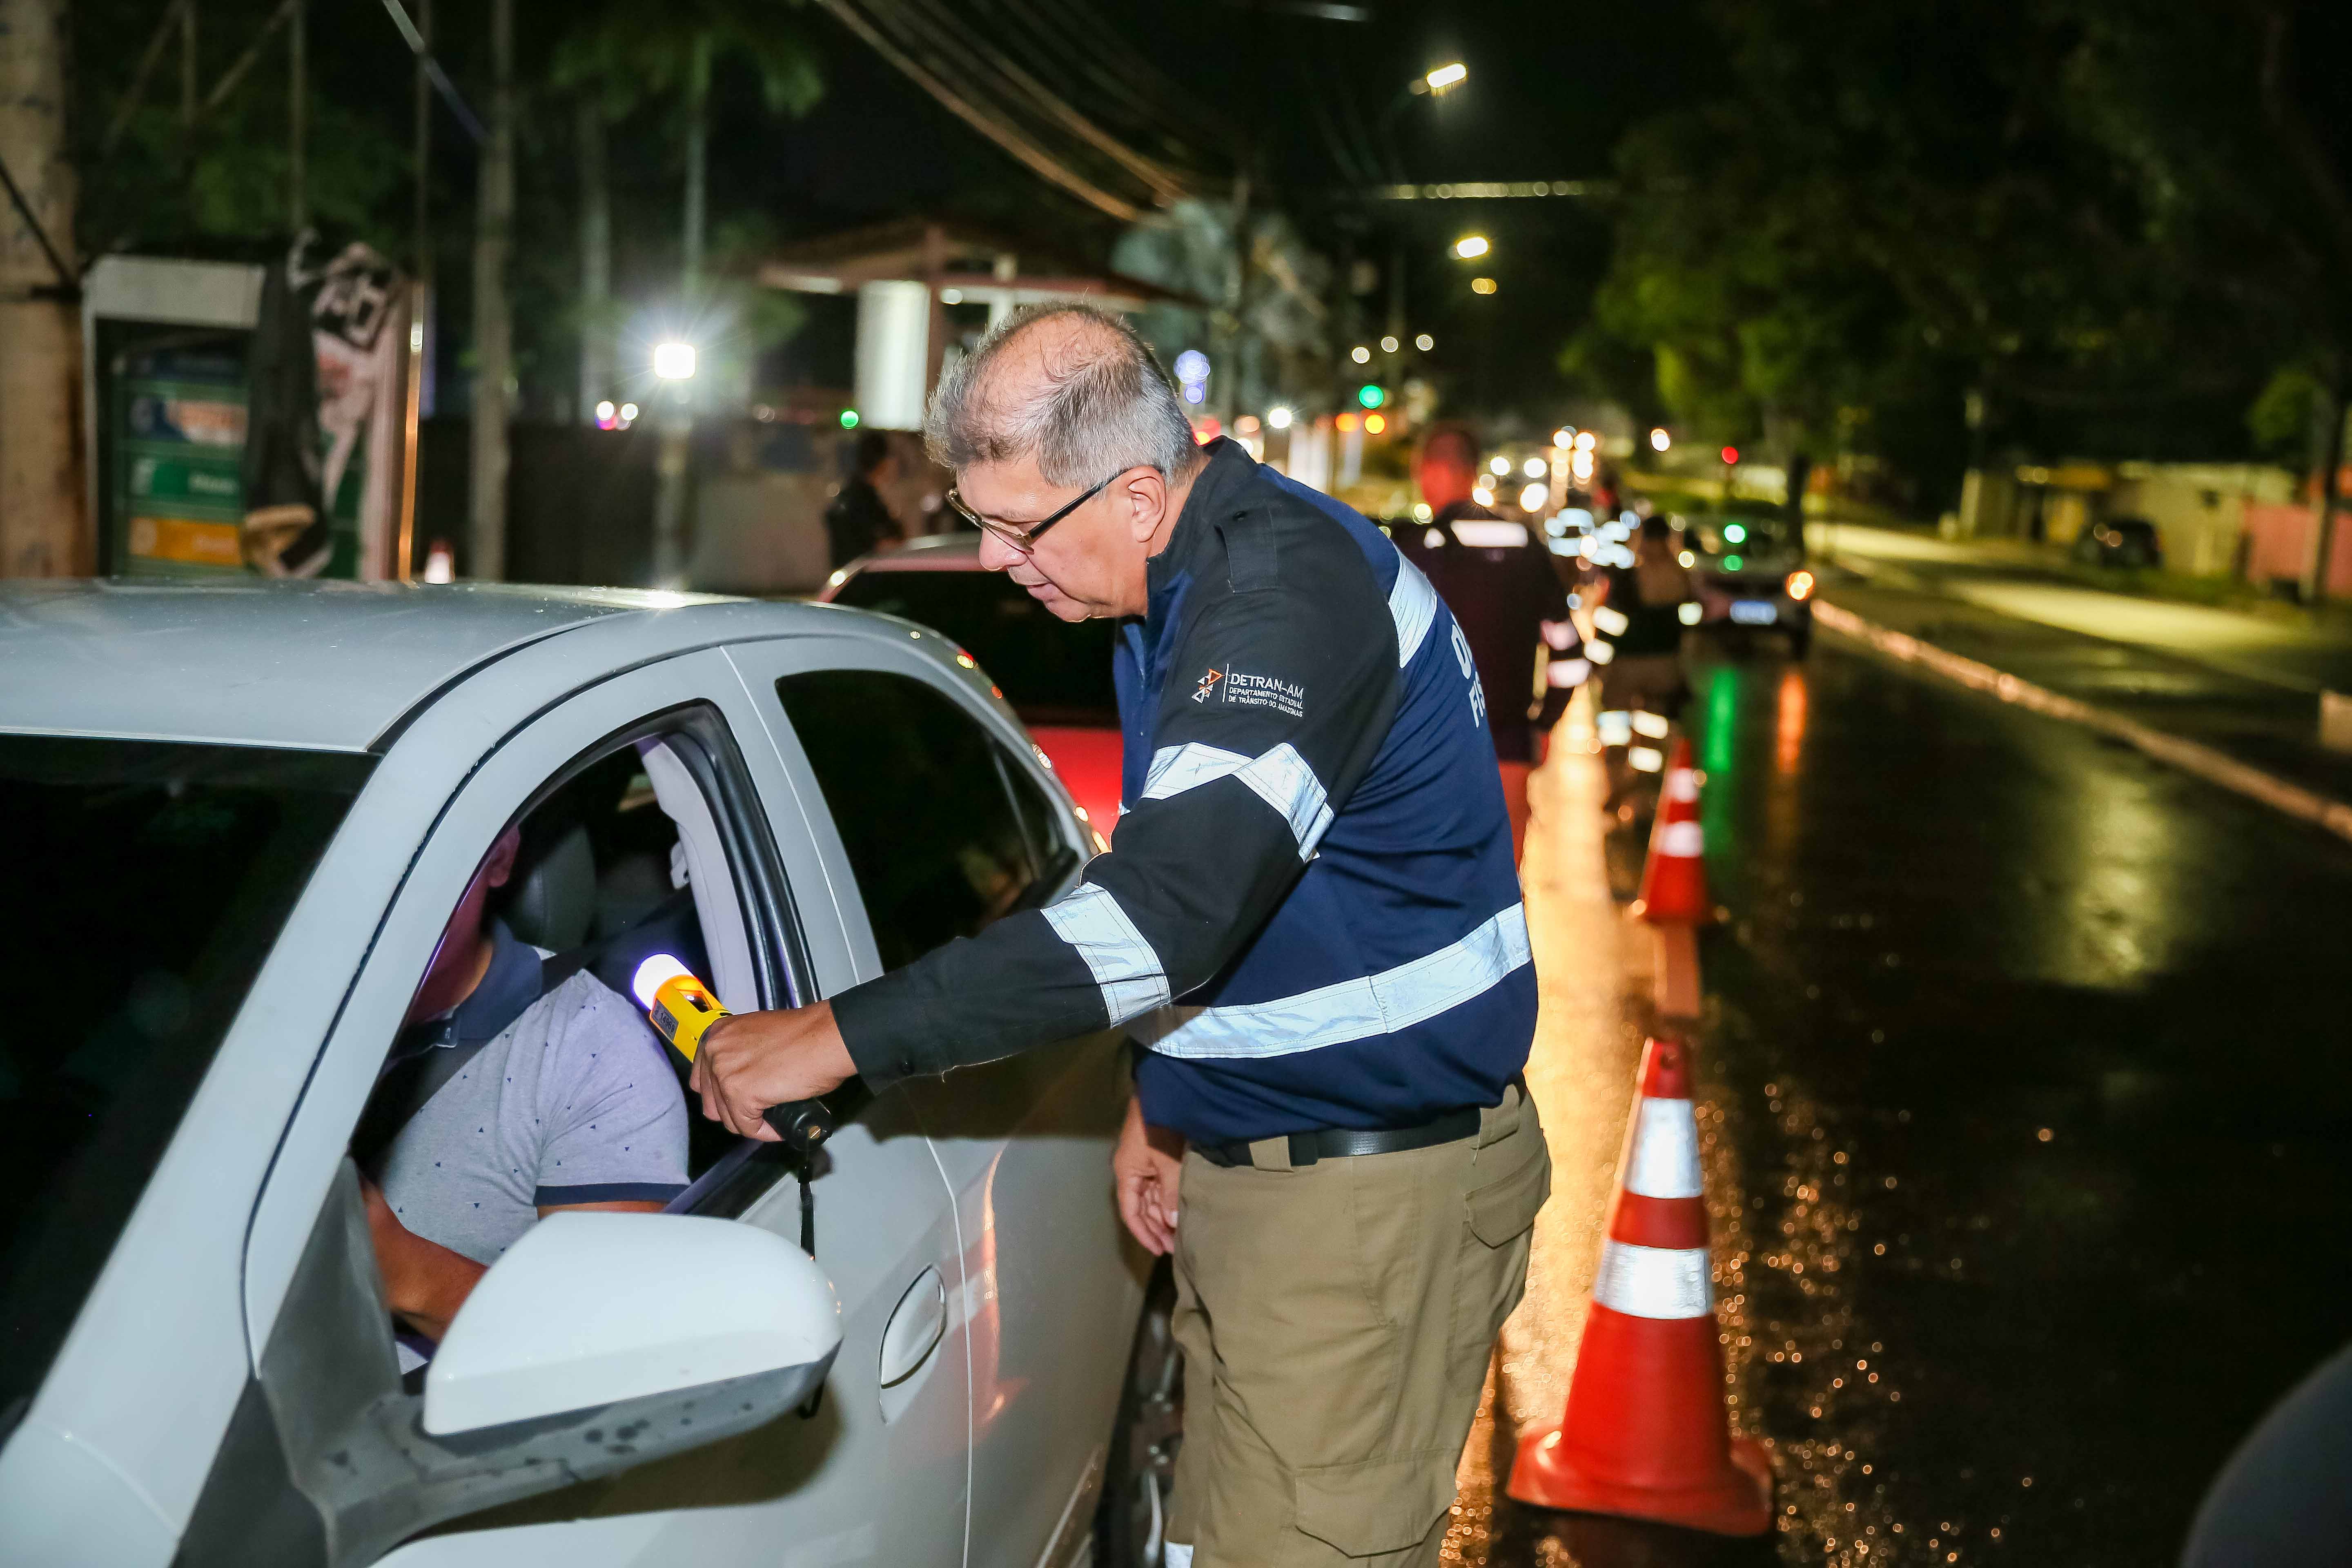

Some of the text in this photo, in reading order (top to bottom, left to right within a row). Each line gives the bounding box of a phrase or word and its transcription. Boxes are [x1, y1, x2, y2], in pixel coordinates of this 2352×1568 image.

[1231, 673, 1303, 699] DETRAN-AM
[1229, 687, 1303, 709] DEPARTAMENTO ESTADUAL
[1238, 695, 1267, 705] TRÂNSITO
[1277, 703, 1303, 717] AMAZONAS
